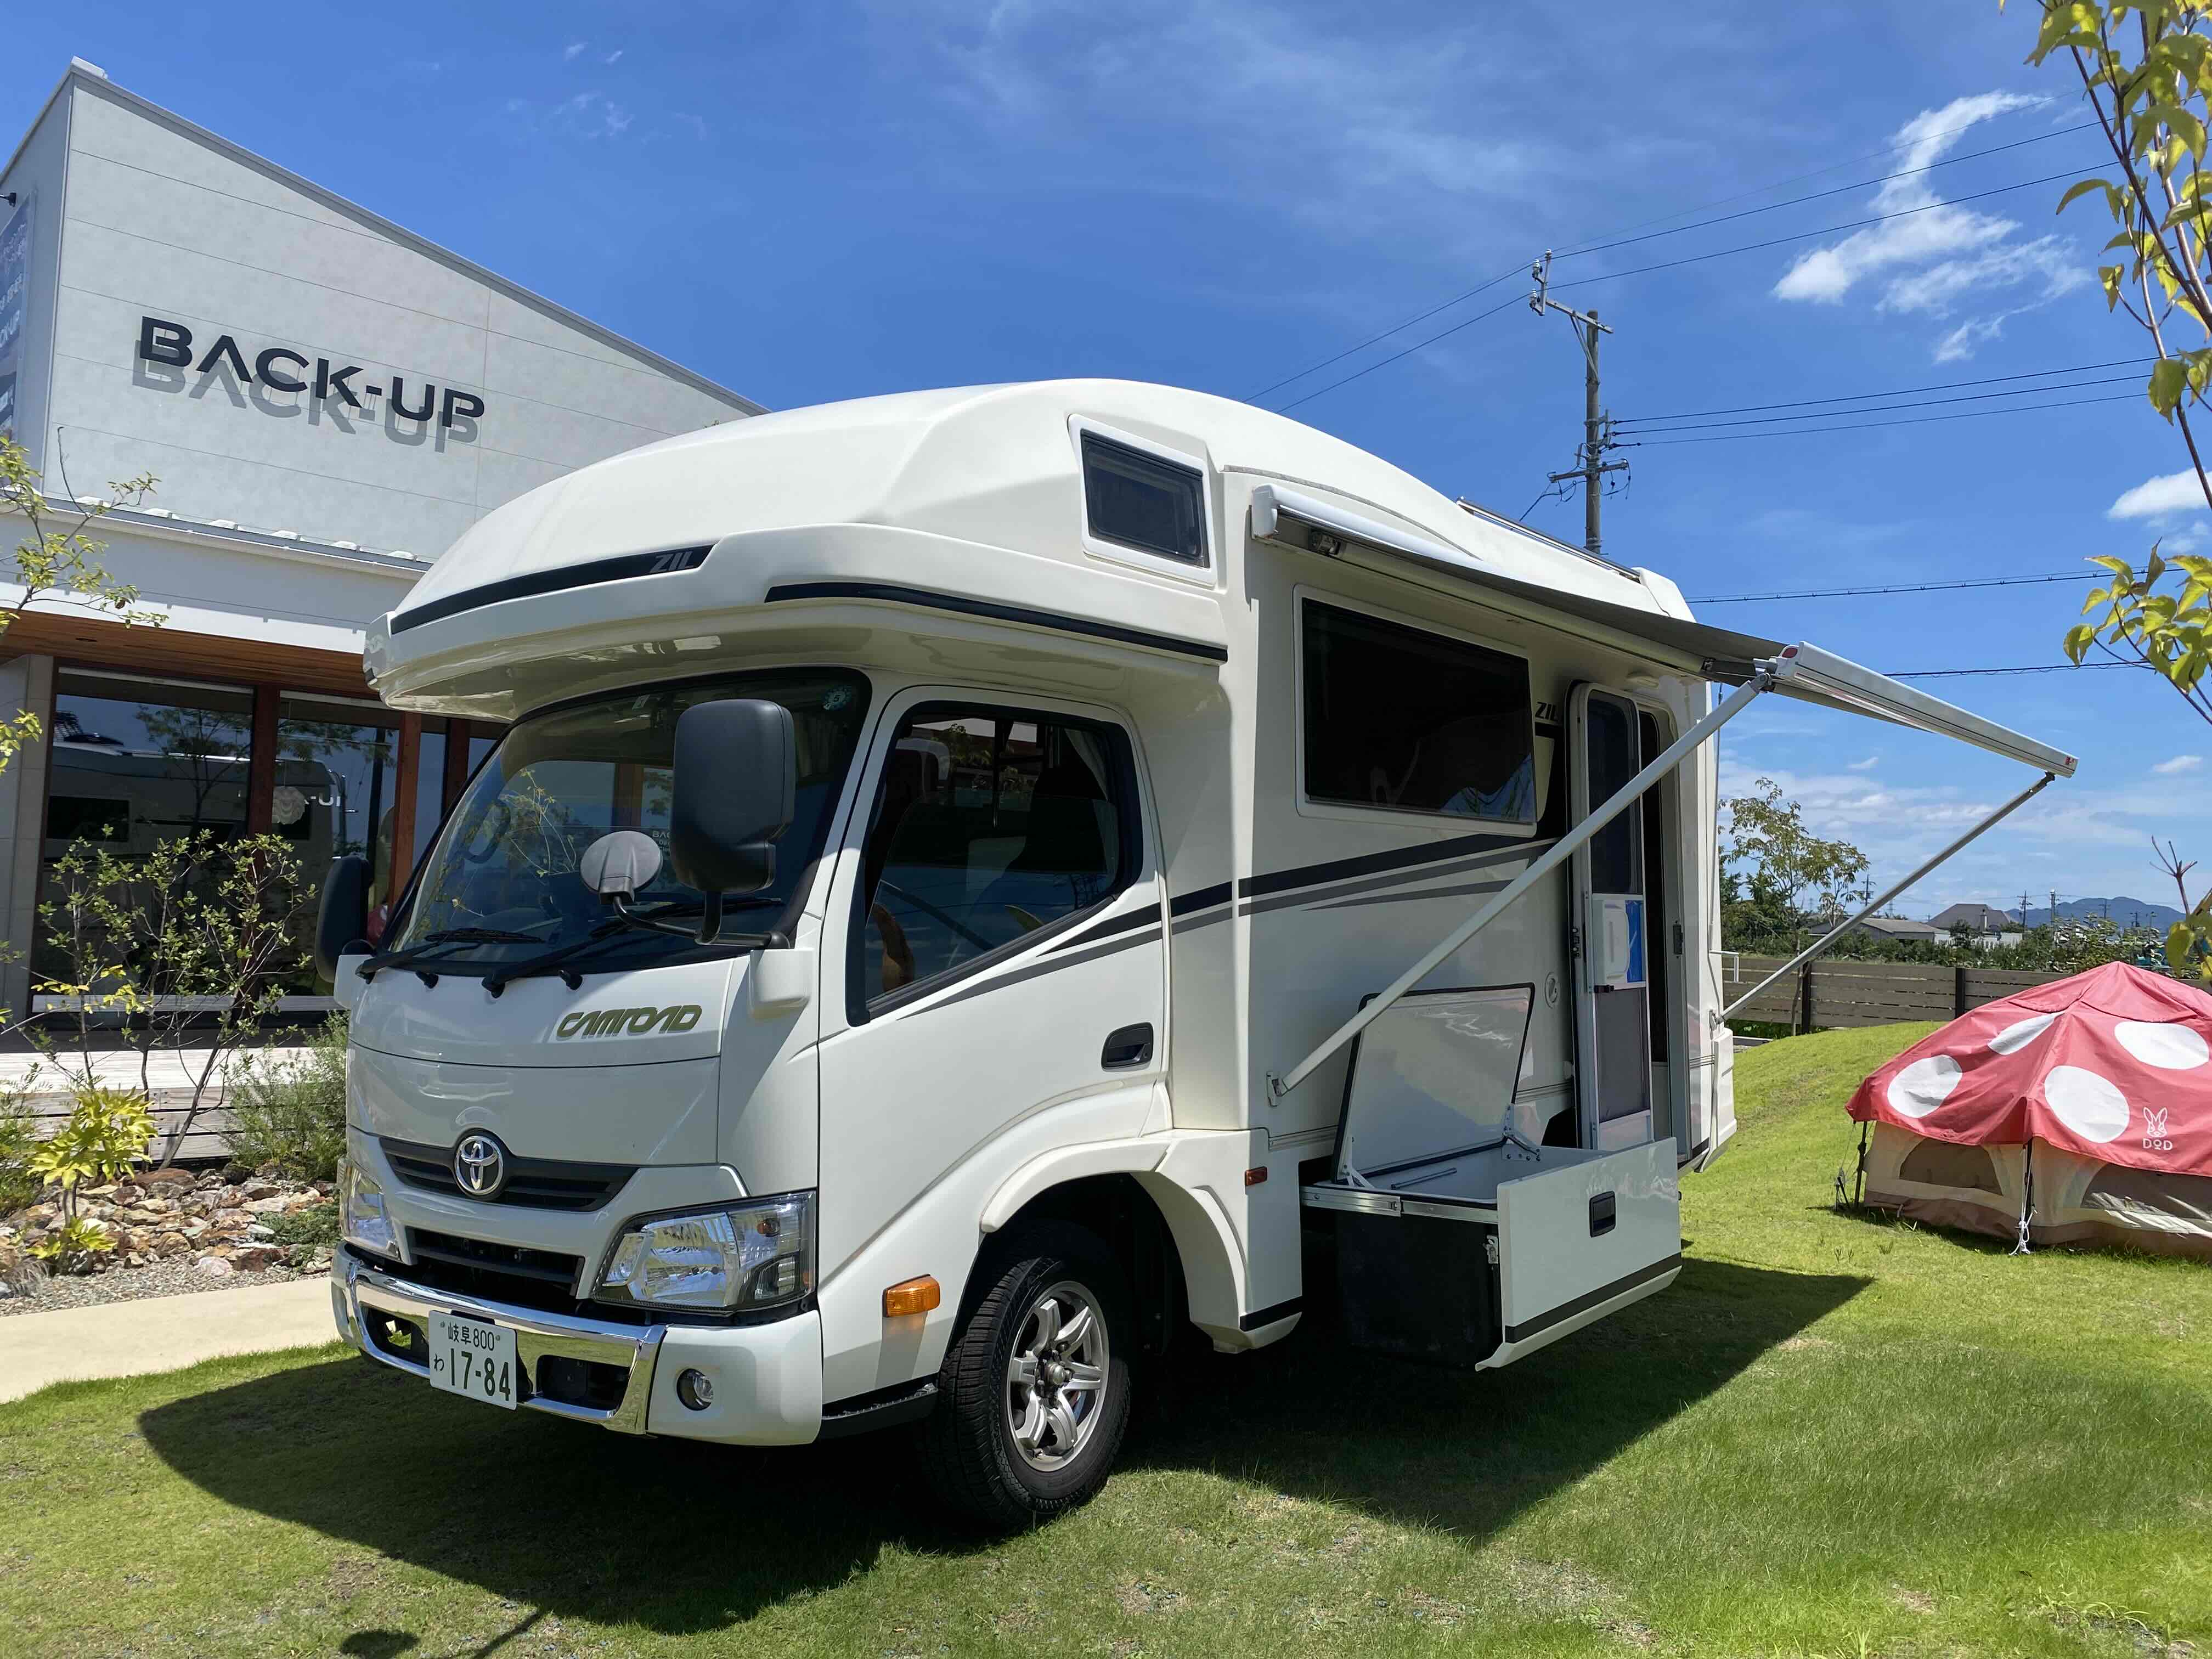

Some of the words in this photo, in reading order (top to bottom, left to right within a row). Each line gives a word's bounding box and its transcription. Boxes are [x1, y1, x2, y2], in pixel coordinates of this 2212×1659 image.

[140, 315, 485, 428] BACK-UP
[650, 551, 693, 574] ZIL
[2142, 1138, 2173, 1150] DOD
[434, 1353, 445, 1372] わ
[450, 1347, 511, 1401] 17-84
